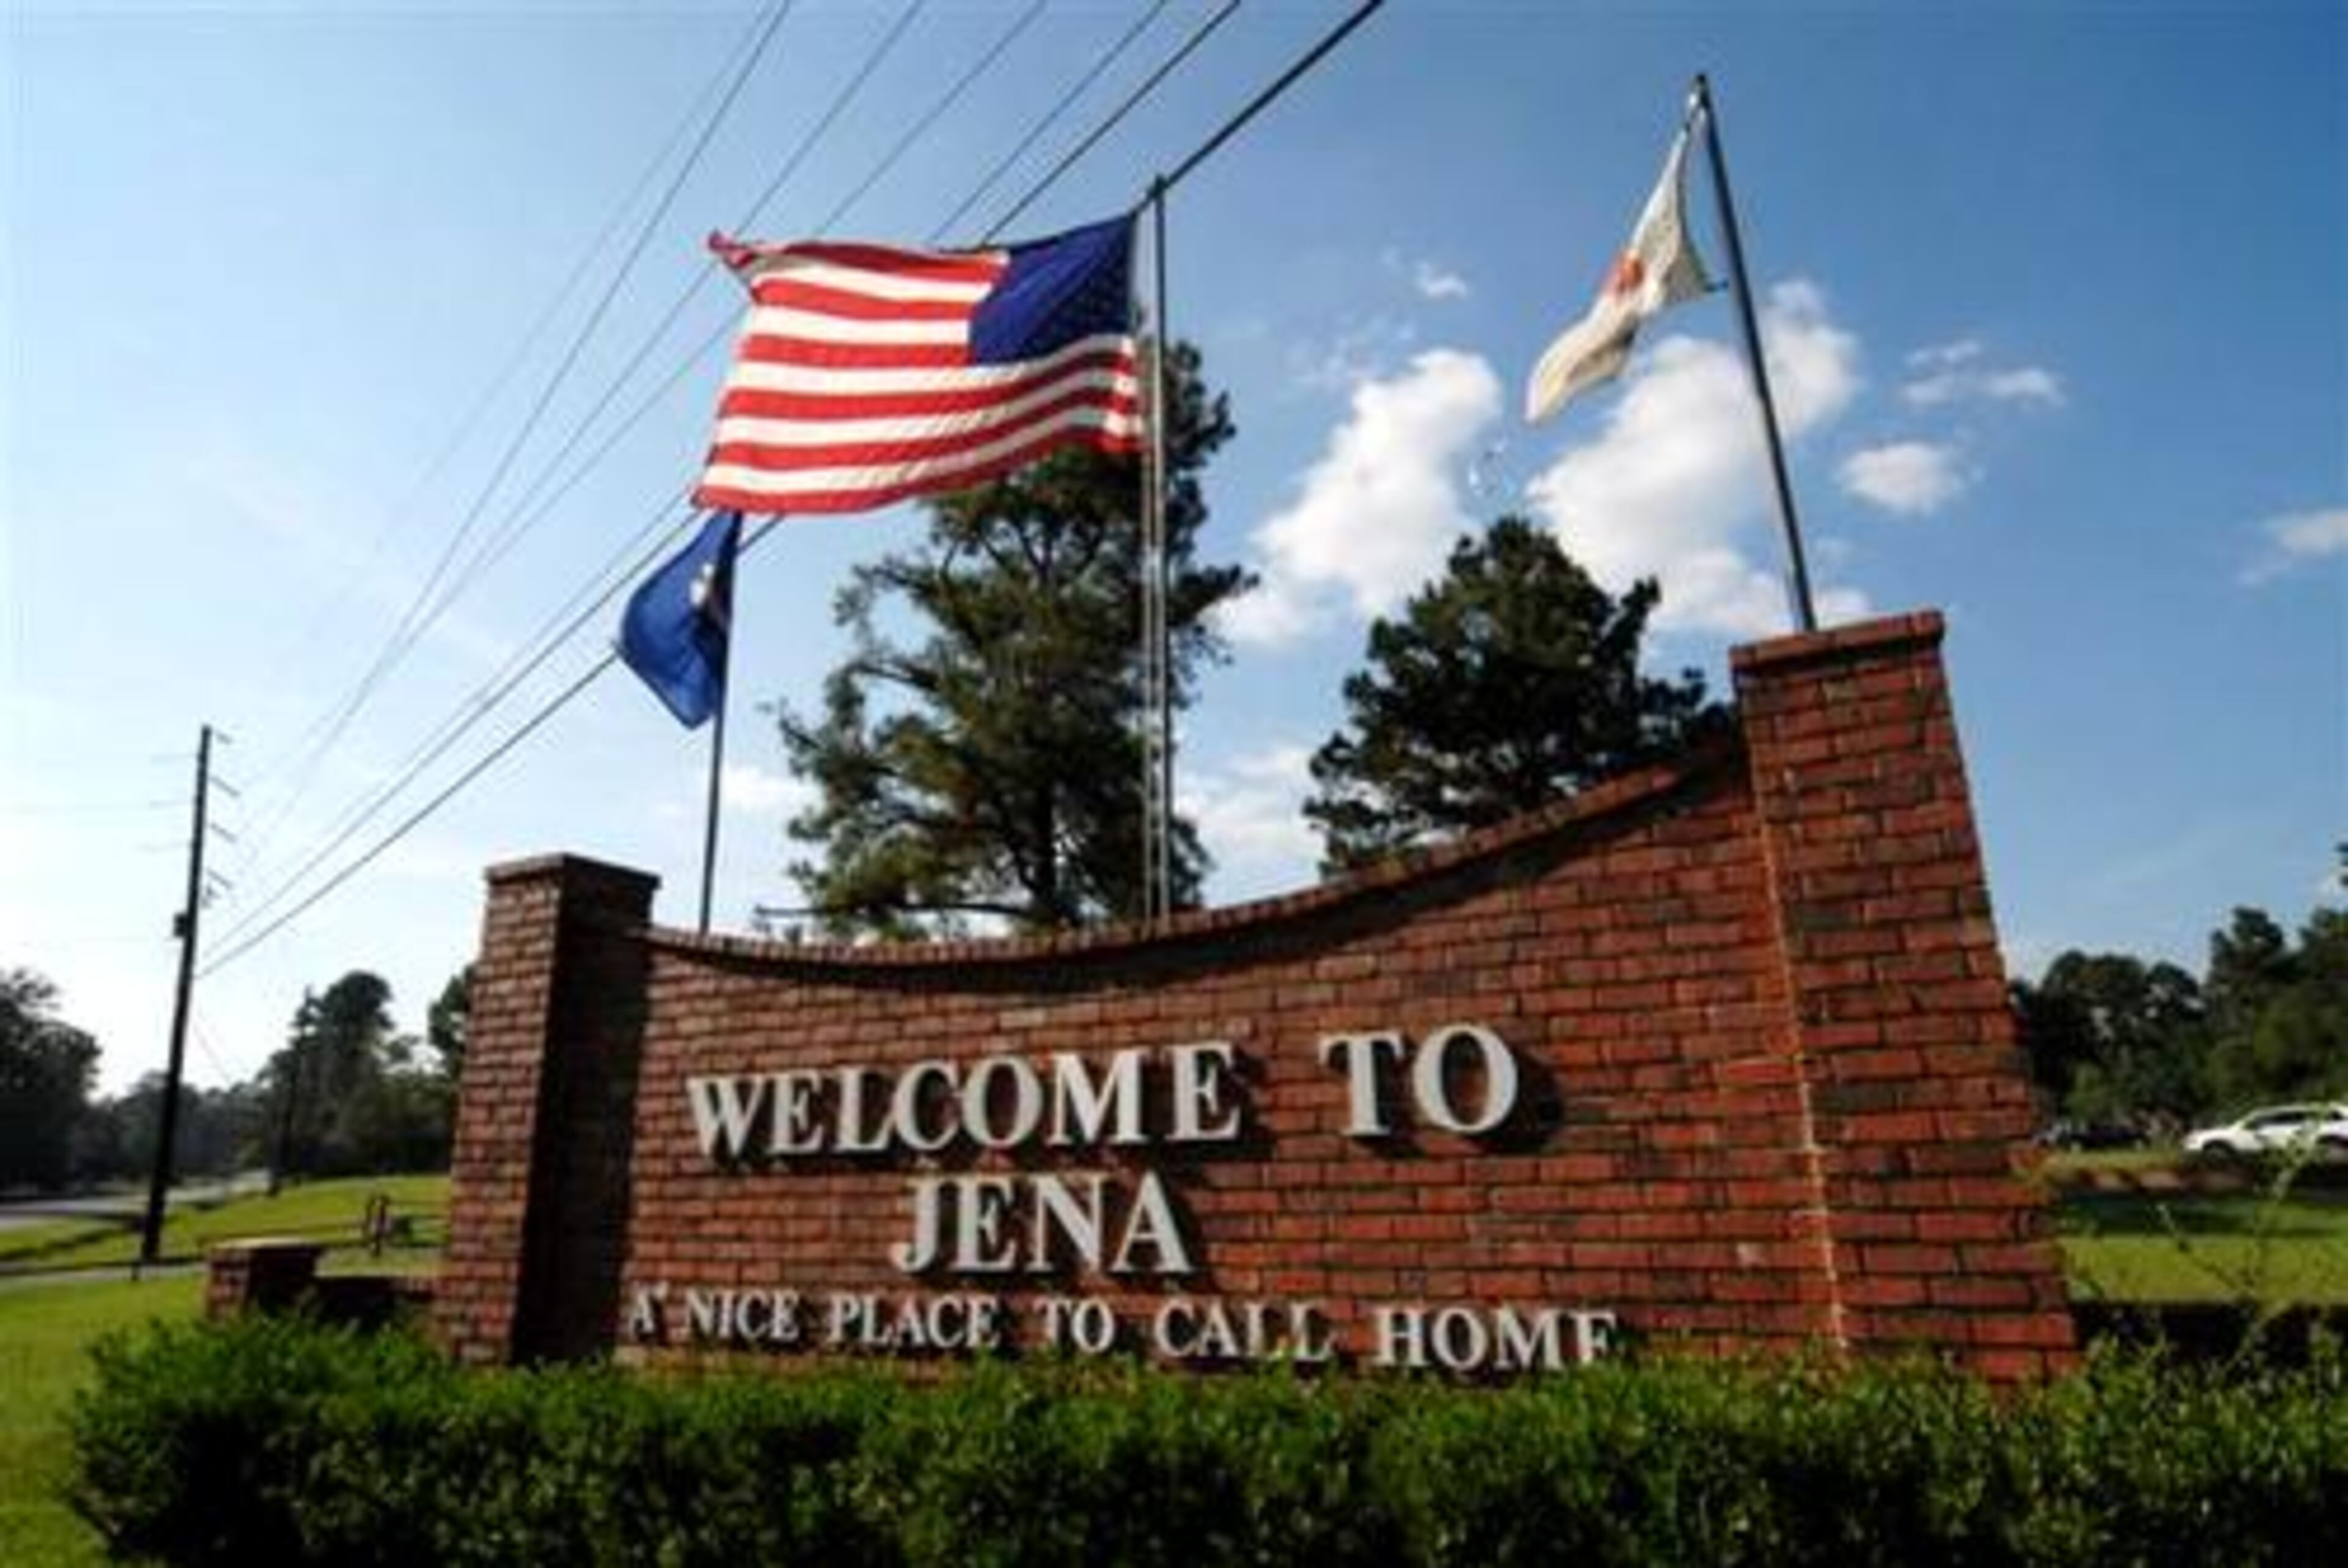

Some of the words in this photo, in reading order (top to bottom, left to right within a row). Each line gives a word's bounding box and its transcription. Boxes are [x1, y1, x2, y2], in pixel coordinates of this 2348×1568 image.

[687, 1042, 1239, 1156] WELCOME
[1317, 1021, 1519, 1136] TO
[888, 1169, 1195, 1272] JENA
[684, 1289, 799, 1341] NICE
[825, 1292, 1000, 1347] PLACE
[1033, 1296, 1115, 1353] TO
[1153, 1298, 1333, 1361] CALL
[1371, 1303, 1617, 1371] HOME
